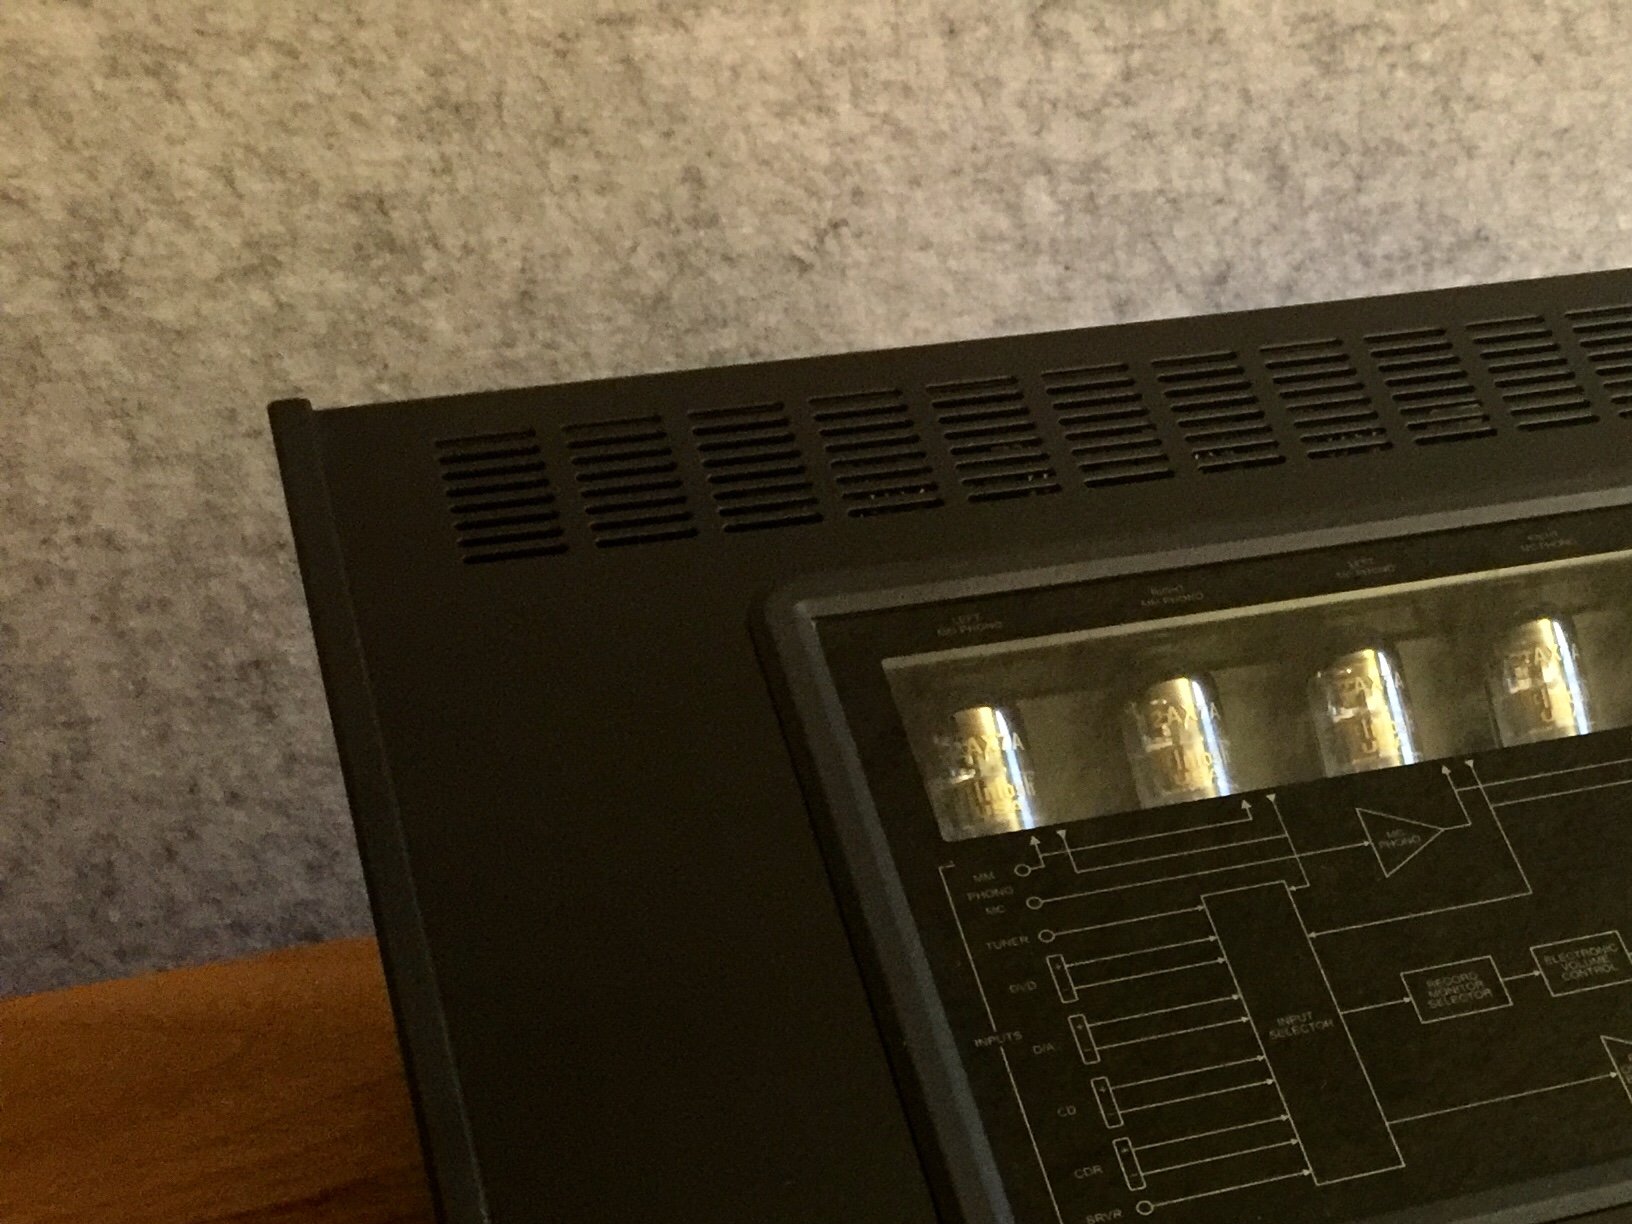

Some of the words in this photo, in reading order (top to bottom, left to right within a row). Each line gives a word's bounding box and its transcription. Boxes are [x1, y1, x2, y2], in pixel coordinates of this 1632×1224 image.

[967, 886, 1014, 902] PHONO
[985, 935, 1029, 952] TUNER
[1544, 942, 1619, 967] ELECTRONIC
[1559, 954, 1610, 973] VOLUME
[1426, 971, 1480, 990] RECORD
[1560, 963, 1616, 982] CONTROL
[1008, 979, 1038, 995] DVD
[1427, 980, 1484, 999] MONITOR
[1427, 988, 1494, 1010] SELECTOR
[1275, 1010, 1314, 1027] INPUT
[974, 1030, 1023, 1048] INPUTS
[1268, 1019, 1336, 1041] SELECTOR
[1032, 1041, 1057, 1056] D/A
[1056, 1105, 1078, 1118] CD
[1073, 1164, 1104, 1180] CDR
